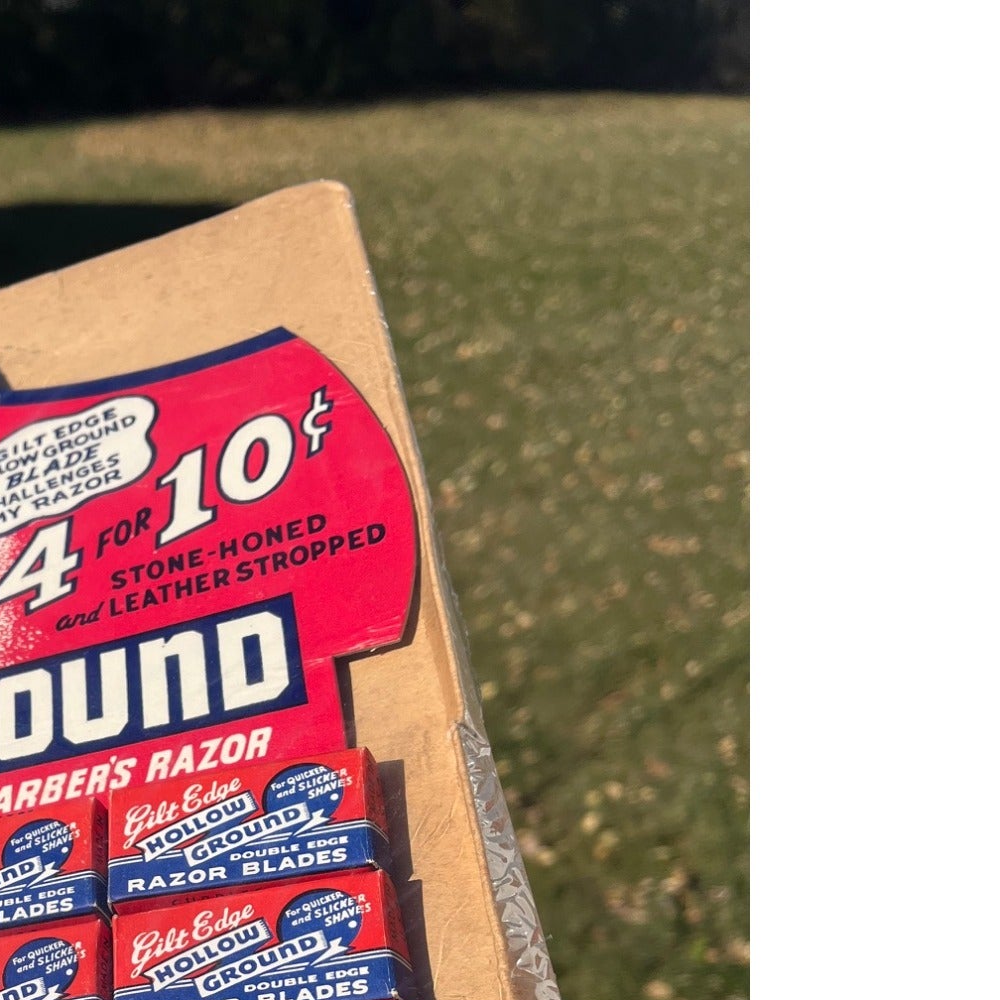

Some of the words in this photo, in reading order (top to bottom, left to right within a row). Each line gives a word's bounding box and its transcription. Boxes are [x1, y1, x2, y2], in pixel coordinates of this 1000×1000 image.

[42, 415, 137, 457] GROUND
[54, 408, 118, 440] EDGE
[6, 443, 101, 491] BLADE
[32, 469, 122, 510] RAZOR
[96, 506, 152, 560] FOR
[111, 513, 328, 591] STONE-HONED
[55, 599, 104, 632] and
[107, 569, 230, 619] LEATHER
[235, 522, 387, 582] STROPPED
[146, 726, 273, 791] RAZOR
[271, 781, 286, 791] For
[287, 765, 327, 785] QUICKER
[276, 785, 296, 799] and
[298, 766, 346, 792] SLICKER
[308, 775, 352, 800] SHAVES
[122, 800, 179, 850] Gilt
[181, 777, 241, 812] Edge
[146, 798, 246, 853] HOLLOW
[191, 809, 301, 861] GROUND
[128, 866, 227, 894] RAZOR
[242, 847, 348, 877] BLADES
[229, 843, 300, 862] DOUBLE
[307, 835, 349, 850] EDGE
